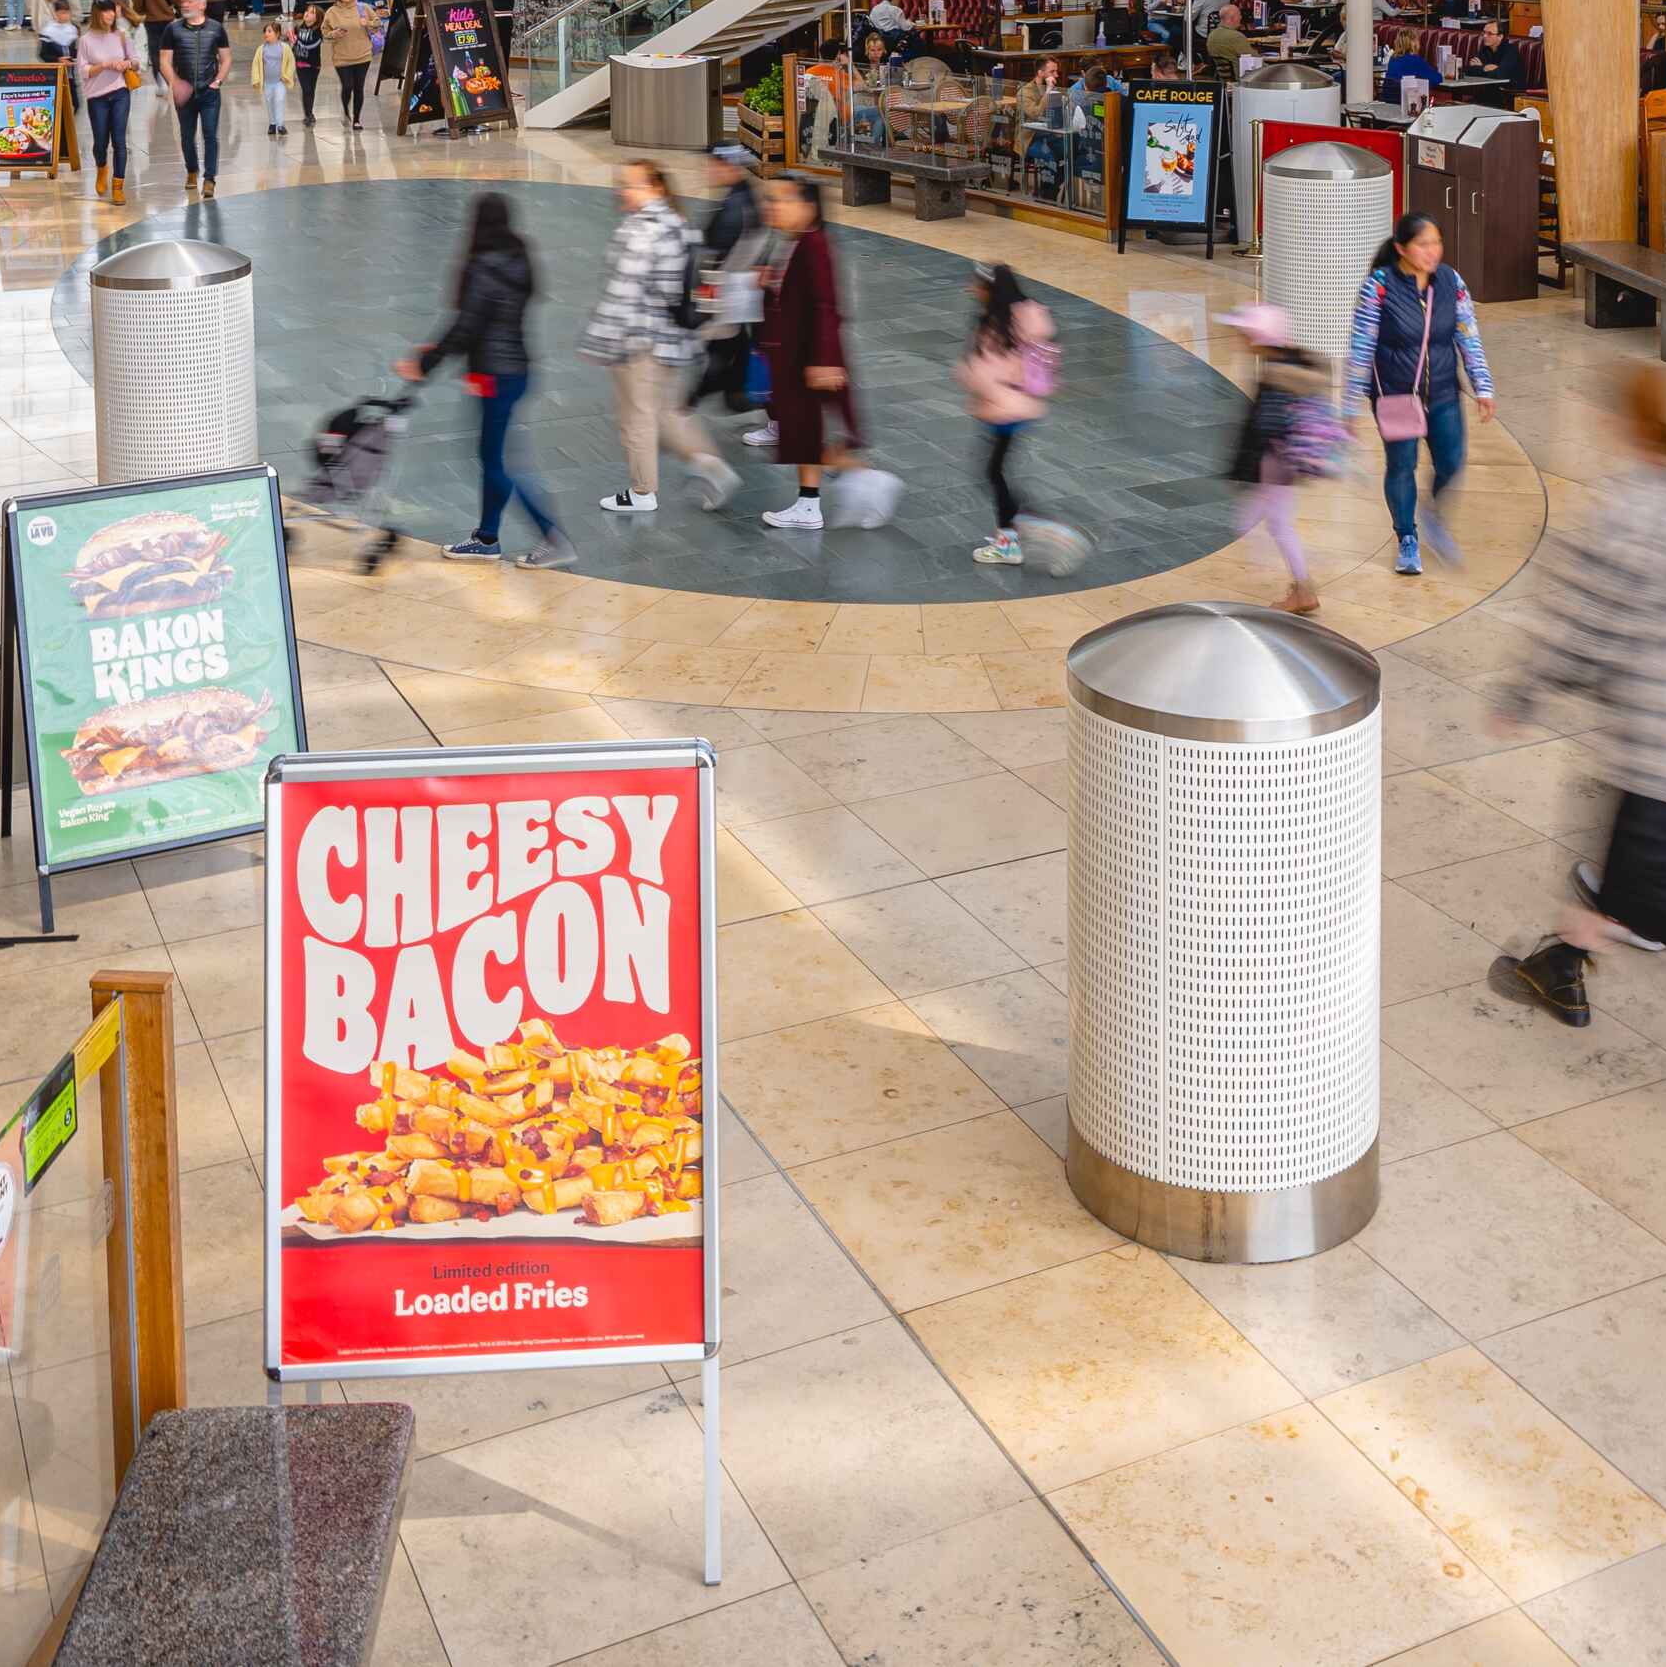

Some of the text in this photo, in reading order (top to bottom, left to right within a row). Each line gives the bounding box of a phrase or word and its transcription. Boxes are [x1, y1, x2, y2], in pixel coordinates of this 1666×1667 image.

[450, 6, 475, 21] kids
[444, 19, 483, 32] MEAL DEAL
[1135, 89, 1213, 102] CAFÉ ROUGE
[89, 609, 225, 663] BAKON
[58, 805, 85, 820] Vegan
[59, 811, 110, 829] Bakon King
[297, 794, 679, 949] CHEESY
[302, 874, 672, 1075] BACON
[432, 1261, 550, 1280] Limited edition
[394, 1282, 589, 1317] Loaded Fries
